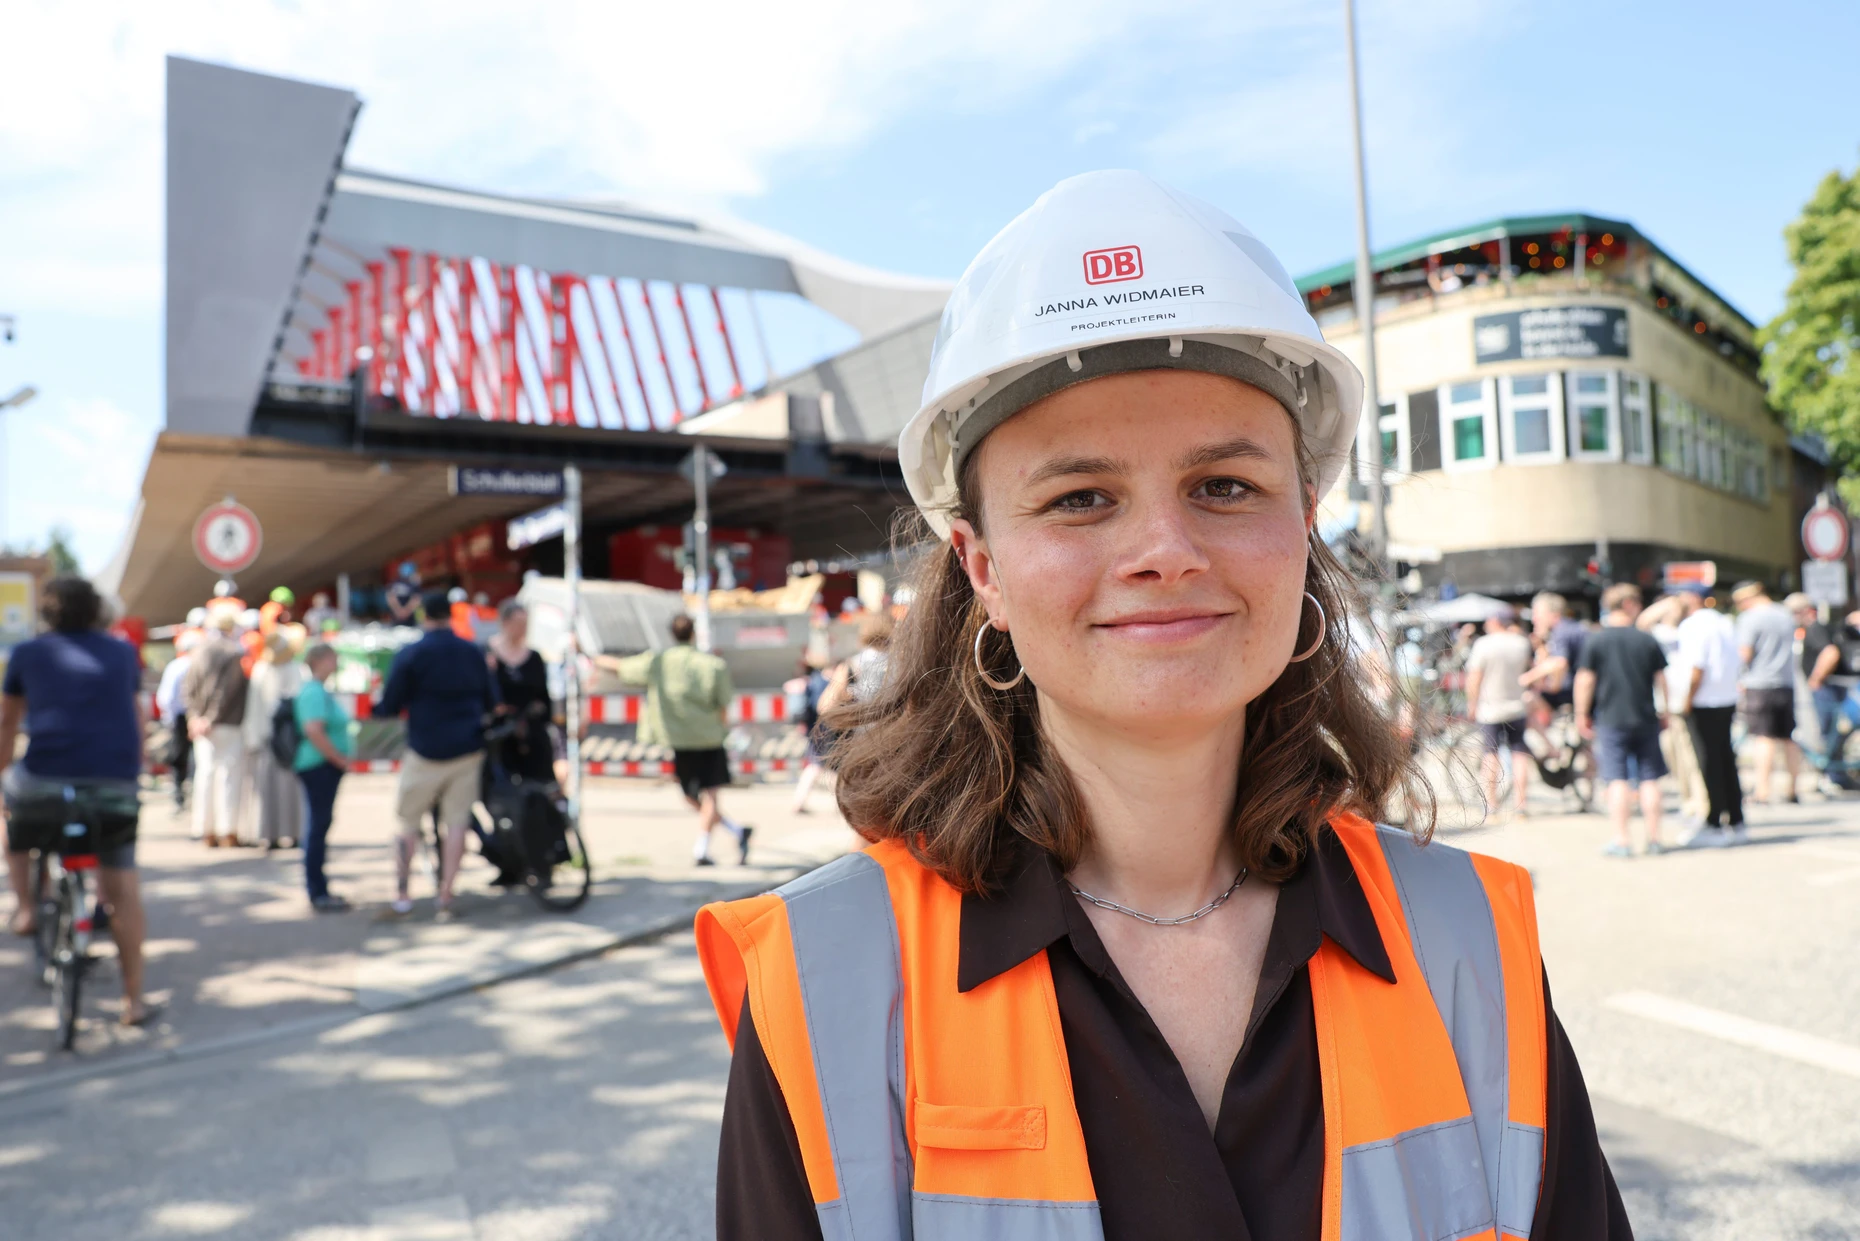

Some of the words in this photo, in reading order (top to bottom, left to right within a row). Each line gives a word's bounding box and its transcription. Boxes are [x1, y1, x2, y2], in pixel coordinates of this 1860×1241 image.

[1090, 251, 1137, 280] DB
[1034, 297, 1099, 317] JANNA
[1103, 285, 1205, 306] WIDMAIER
[1070, 312, 1177, 331] PROJEKTLEITERIN
